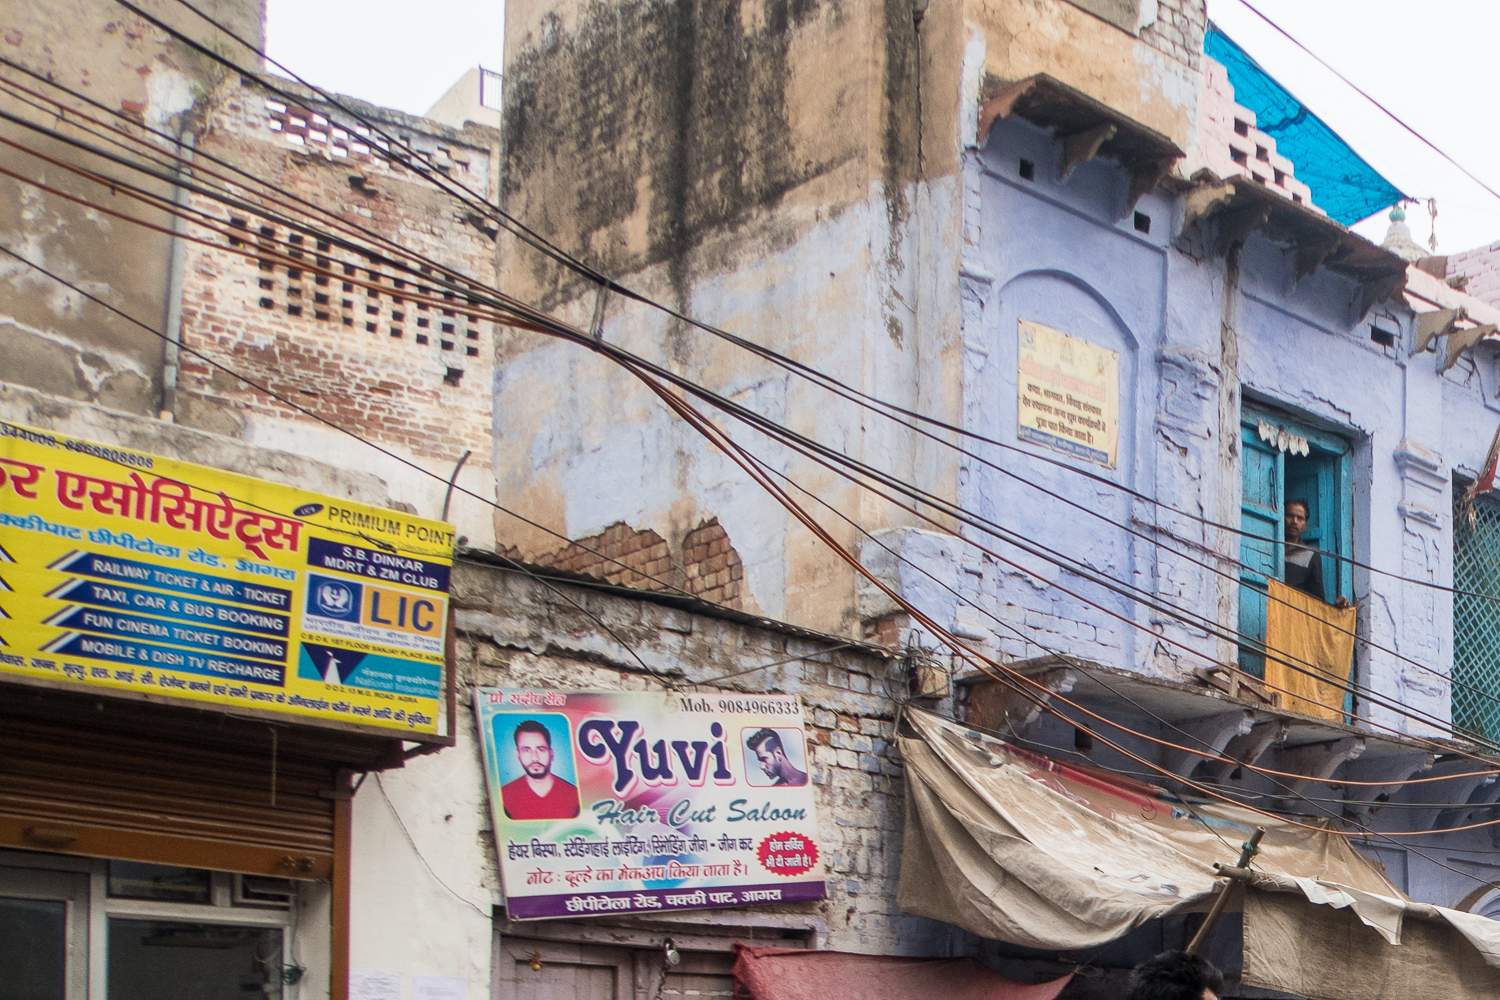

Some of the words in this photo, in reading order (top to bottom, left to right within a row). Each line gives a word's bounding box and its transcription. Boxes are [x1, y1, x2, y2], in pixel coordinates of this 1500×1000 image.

[328, 506, 400, 536] PRIMIUM
[406, 524, 456, 547] POINT
[234, 559, 297, 581] आगरा
[324, 556, 364, 573] MDRT
[366, 564, 377, 576] &
[380, 567, 399, 581] ZM
[403, 572, 438, 589] CLUB
[343, 546, 370, 562] S.B.
[372, 554, 423, 573] DINKAR
[93, 559, 150, 580] RAILWAY
[154, 570, 198, 589] TICKET
[201, 580, 210, 591] &
[212, 582, 234, 596] AIR
[244, 587, 287, 606] TICKET
[133, 593, 166, 610] CAR
[170, 601, 180, 612] &
[184, 603, 214, 619] BUS
[217, 609, 284, 631] BOOKING
[371, 591, 435, 632] LIC
[84, 613, 113, 629] FUN
[116, 619, 169, 638] CINEMA
[173, 628, 220, 645] TICKET
[223, 636, 284, 657] BOOKING
[346, 640, 370, 650] FLOOR
[401, 650, 422, 659] PLACE
[82, 639, 136, 660] MOBILE
[139, 649, 149, 661] &
[153, 652, 184, 666] DISH
[188, 656, 206, 669] TV
[208, 660, 281, 682] RECHARGE
[374, 692, 394, 700] ROAD
[680, 698, 714, 714] Mob.
[719, 700, 799, 715] 9084966333
[578, 719, 734, 794] Yuvi
[592, 800, 658, 826] Hair
[669, 799, 716, 827] Cut
[726, 798, 807, 823] Saloon
[508, 840, 529, 860] हेयर
[565, 865, 592, 887] दूल्हे
[596, 869, 614, 880] का
[618, 864, 664, 880] मेकअप
[668, 860, 699, 878] किया
[565, 895, 630, 912] छीपीटोला
[634, 893, 662, 909] रोड,
[664, 890, 706, 906] चक्की
[710, 890, 738, 905] पाट,
[742, 889, 782, 903] आगरा
